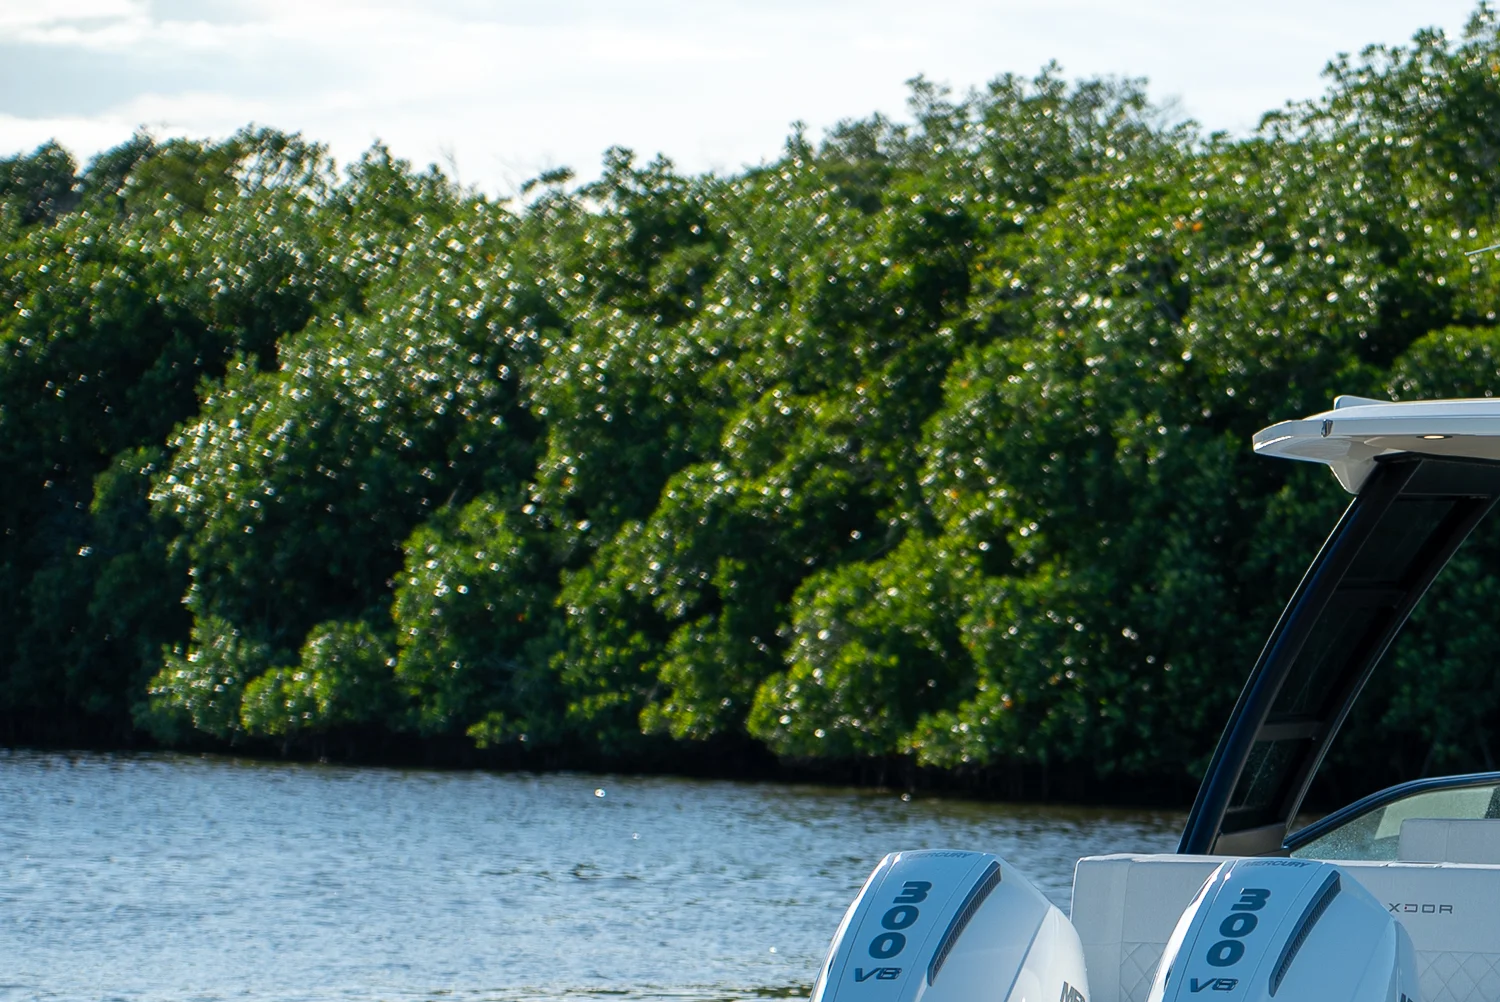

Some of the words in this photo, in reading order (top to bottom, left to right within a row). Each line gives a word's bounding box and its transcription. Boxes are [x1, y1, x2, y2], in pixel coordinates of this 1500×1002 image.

[1242, 860, 1311, 868] MERCURY
[1388, 902, 1454, 915] XDOR
[868, 881, 932, 960] 300
[1206, 888, 1271, 967] 300
[854, 967, 902, 983] V8
[1190, 977, 1239, 993] V8
